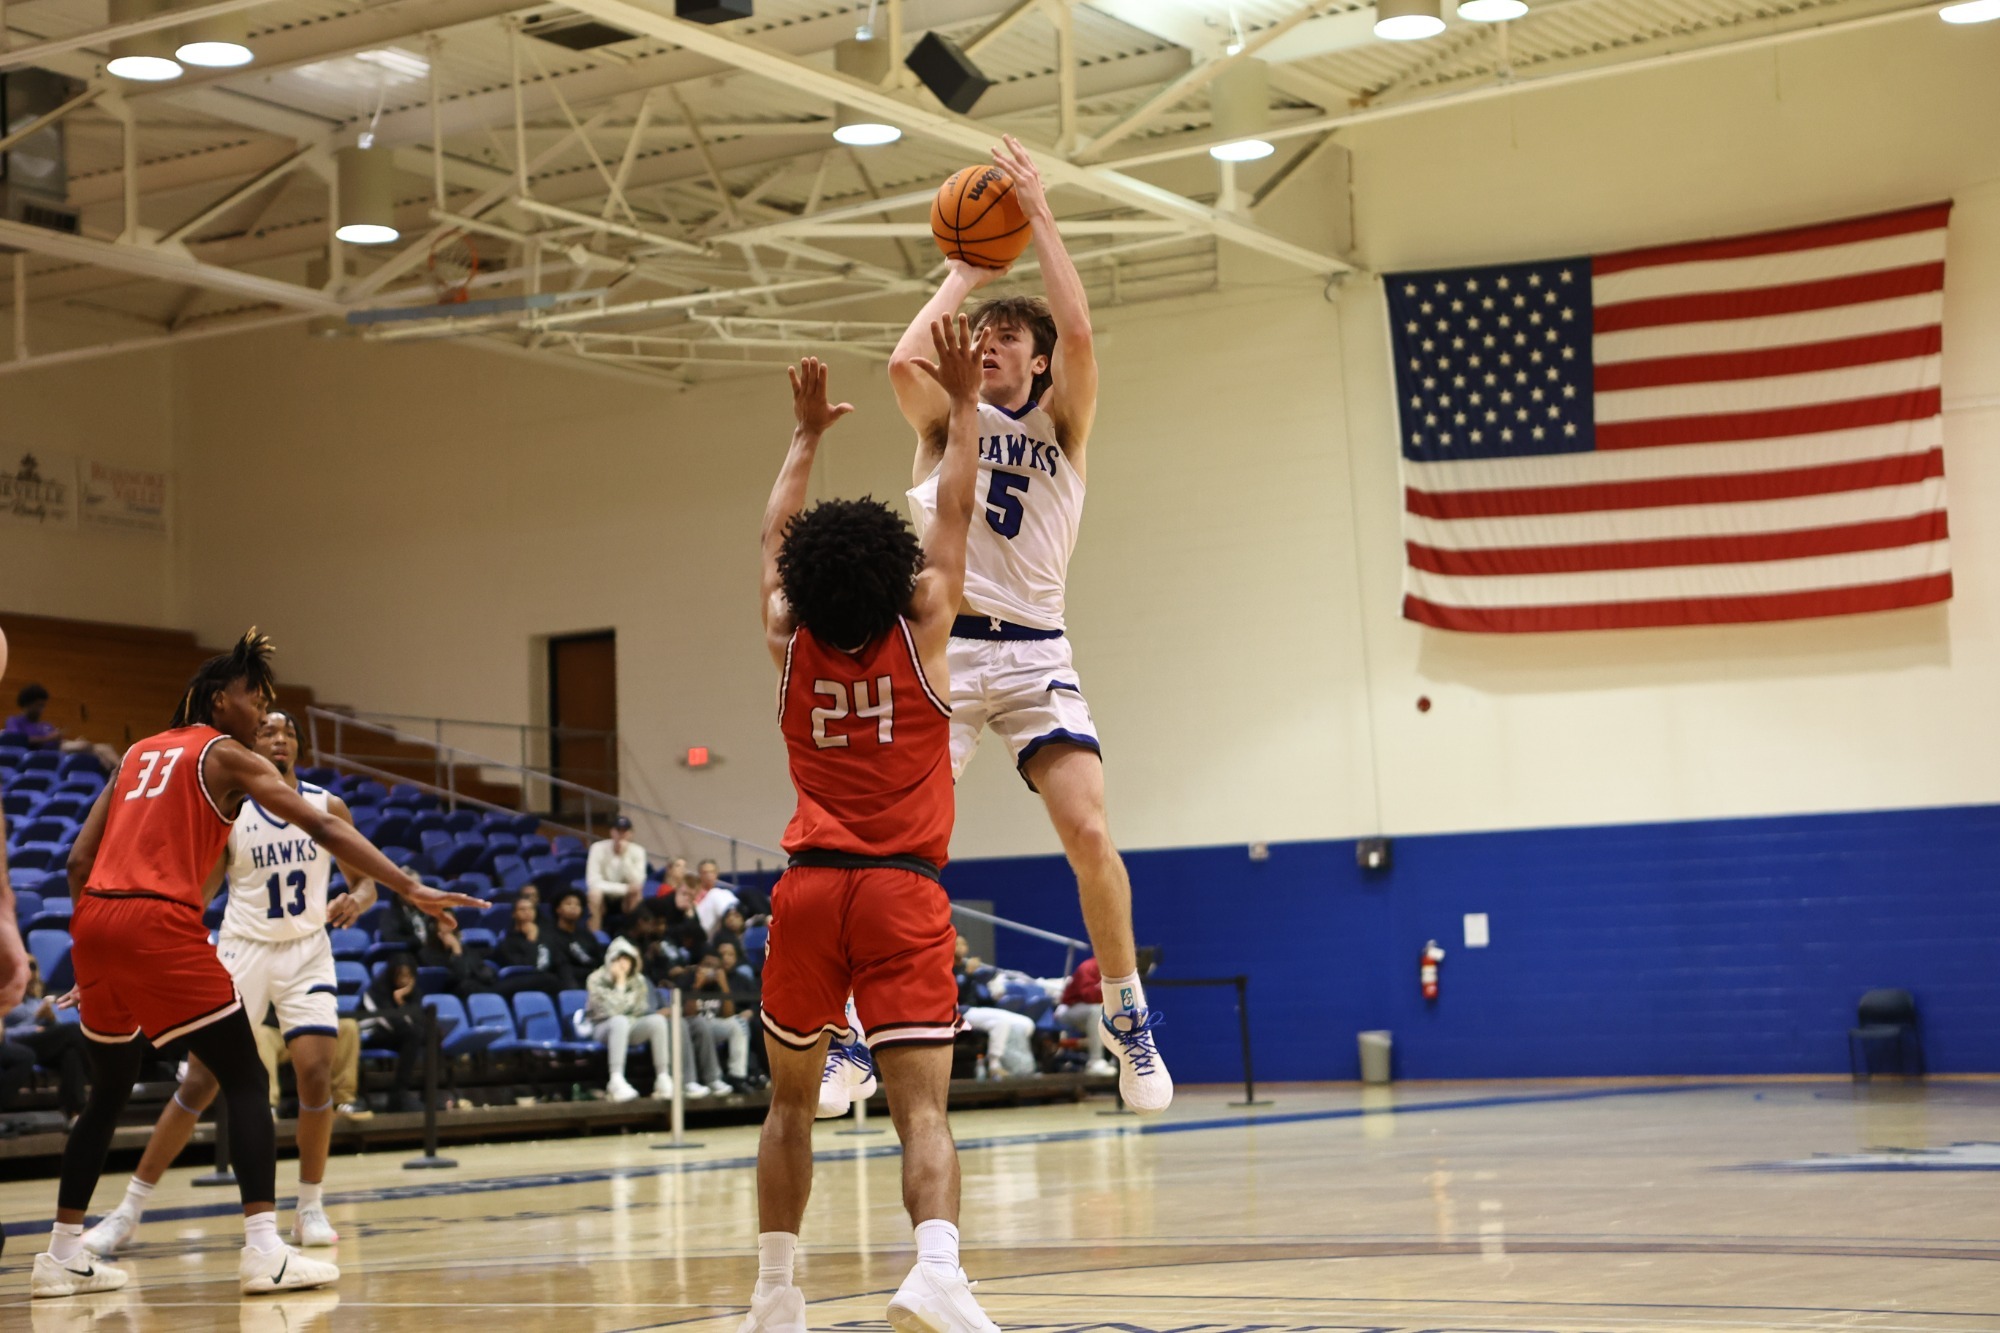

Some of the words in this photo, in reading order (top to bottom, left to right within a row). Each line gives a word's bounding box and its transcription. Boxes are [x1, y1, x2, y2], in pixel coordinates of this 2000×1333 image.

[985, 468, 1031, 541] 5
[810, 674, 895, 751] 24
[123, 746, 184, 802] 33
[250, 839, 317, 869] HAWKS
[265, 869, 307, 919] 13
